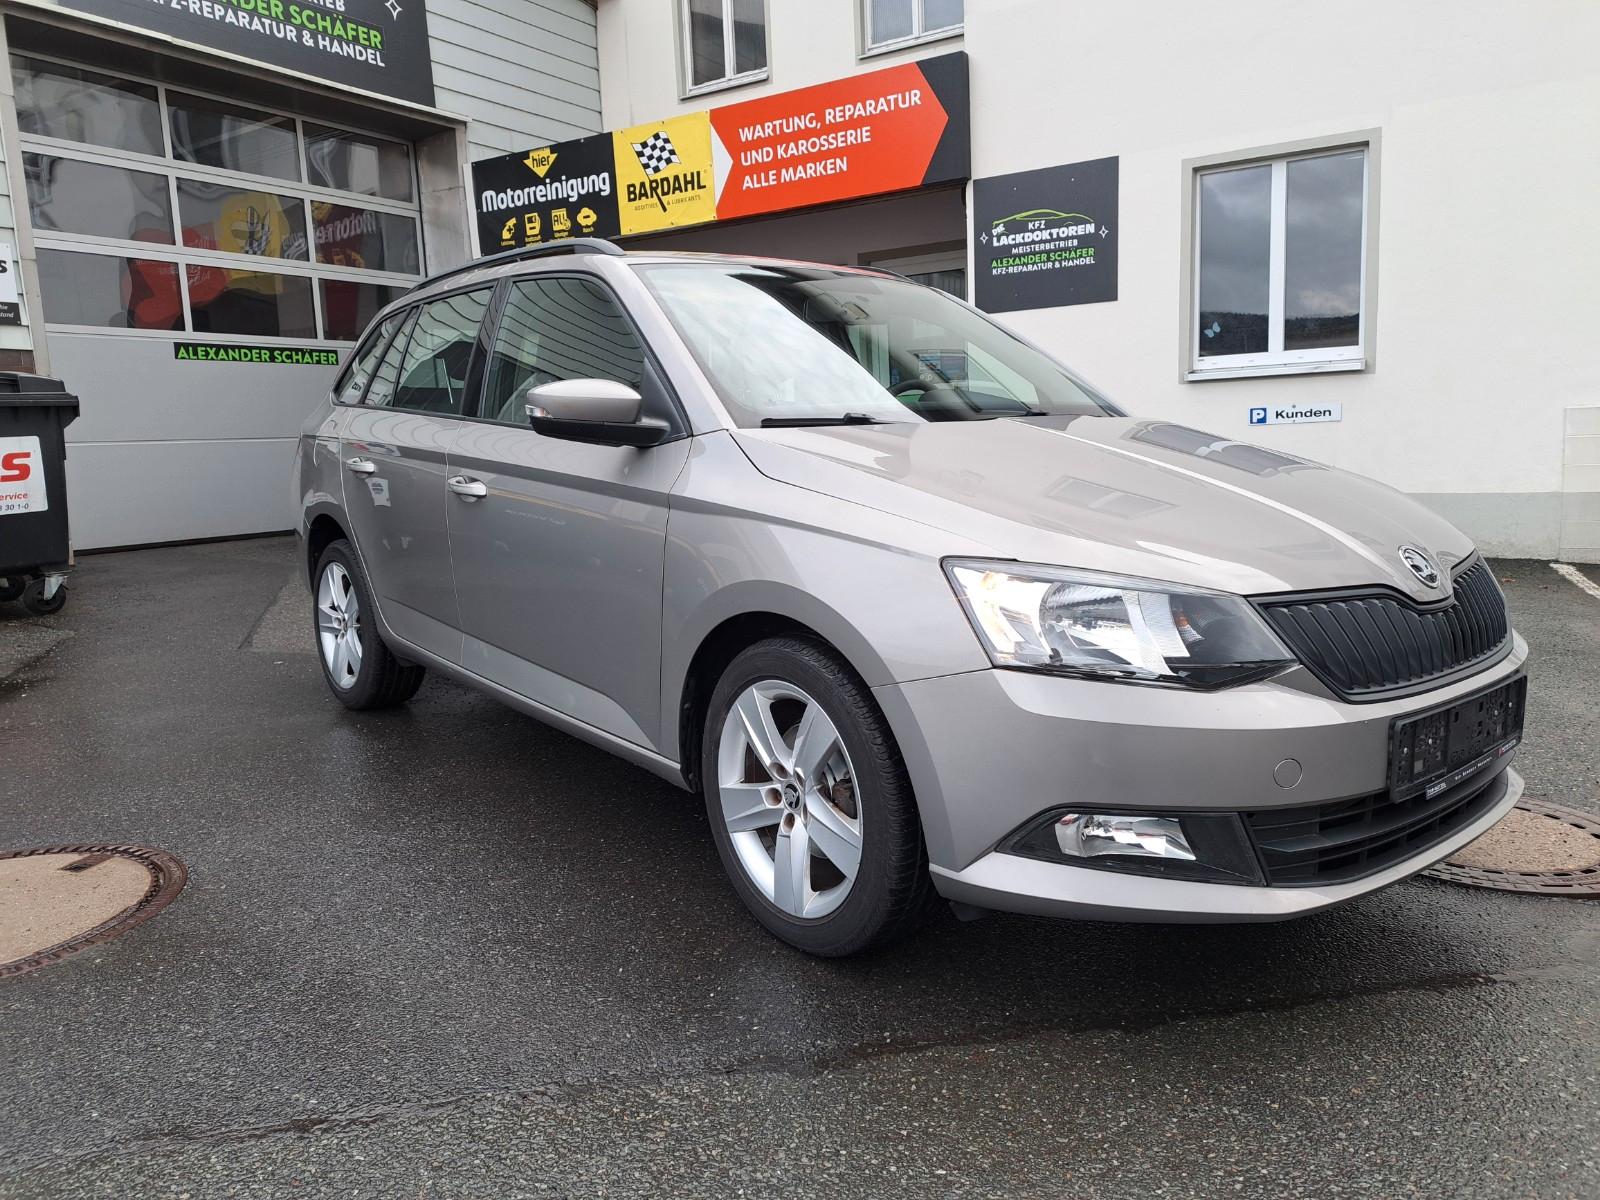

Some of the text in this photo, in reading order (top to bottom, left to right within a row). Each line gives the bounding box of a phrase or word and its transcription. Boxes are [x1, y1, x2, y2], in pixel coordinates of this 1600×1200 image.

[152, 0, 385, 67] Z-REPARATUR & HANDEL
[289, 5, 382, 49] SCHÄFER
[738, 89, 922, 143] WARTUNG, REPARATUR
[740, 126, 872, 167] UND KAROSSERIE
[531, 151, 551, 168] hier
[742, 156, 848, 190] ALLE MARKEN
[481, 172, 610, 213] Motorreinigung
[626, 170, 706, 203] BARDAHL
[992, 223, 1095, 247] LACKDOKTOREN
[1028, 220, 1046, 230] KFZ
[991, 247, 1095, 268] ALEXANDER SCHÄFER
[1011, 239, 1078, 254] MEISTERBETRIEB
[992, 256, 1096, 276] KFZ-REPARATUR & HANDEL
[177, 346, 337, 365] ALEXANDER SCHÄFER
[1275, 408, 1332, 419] Kunden
